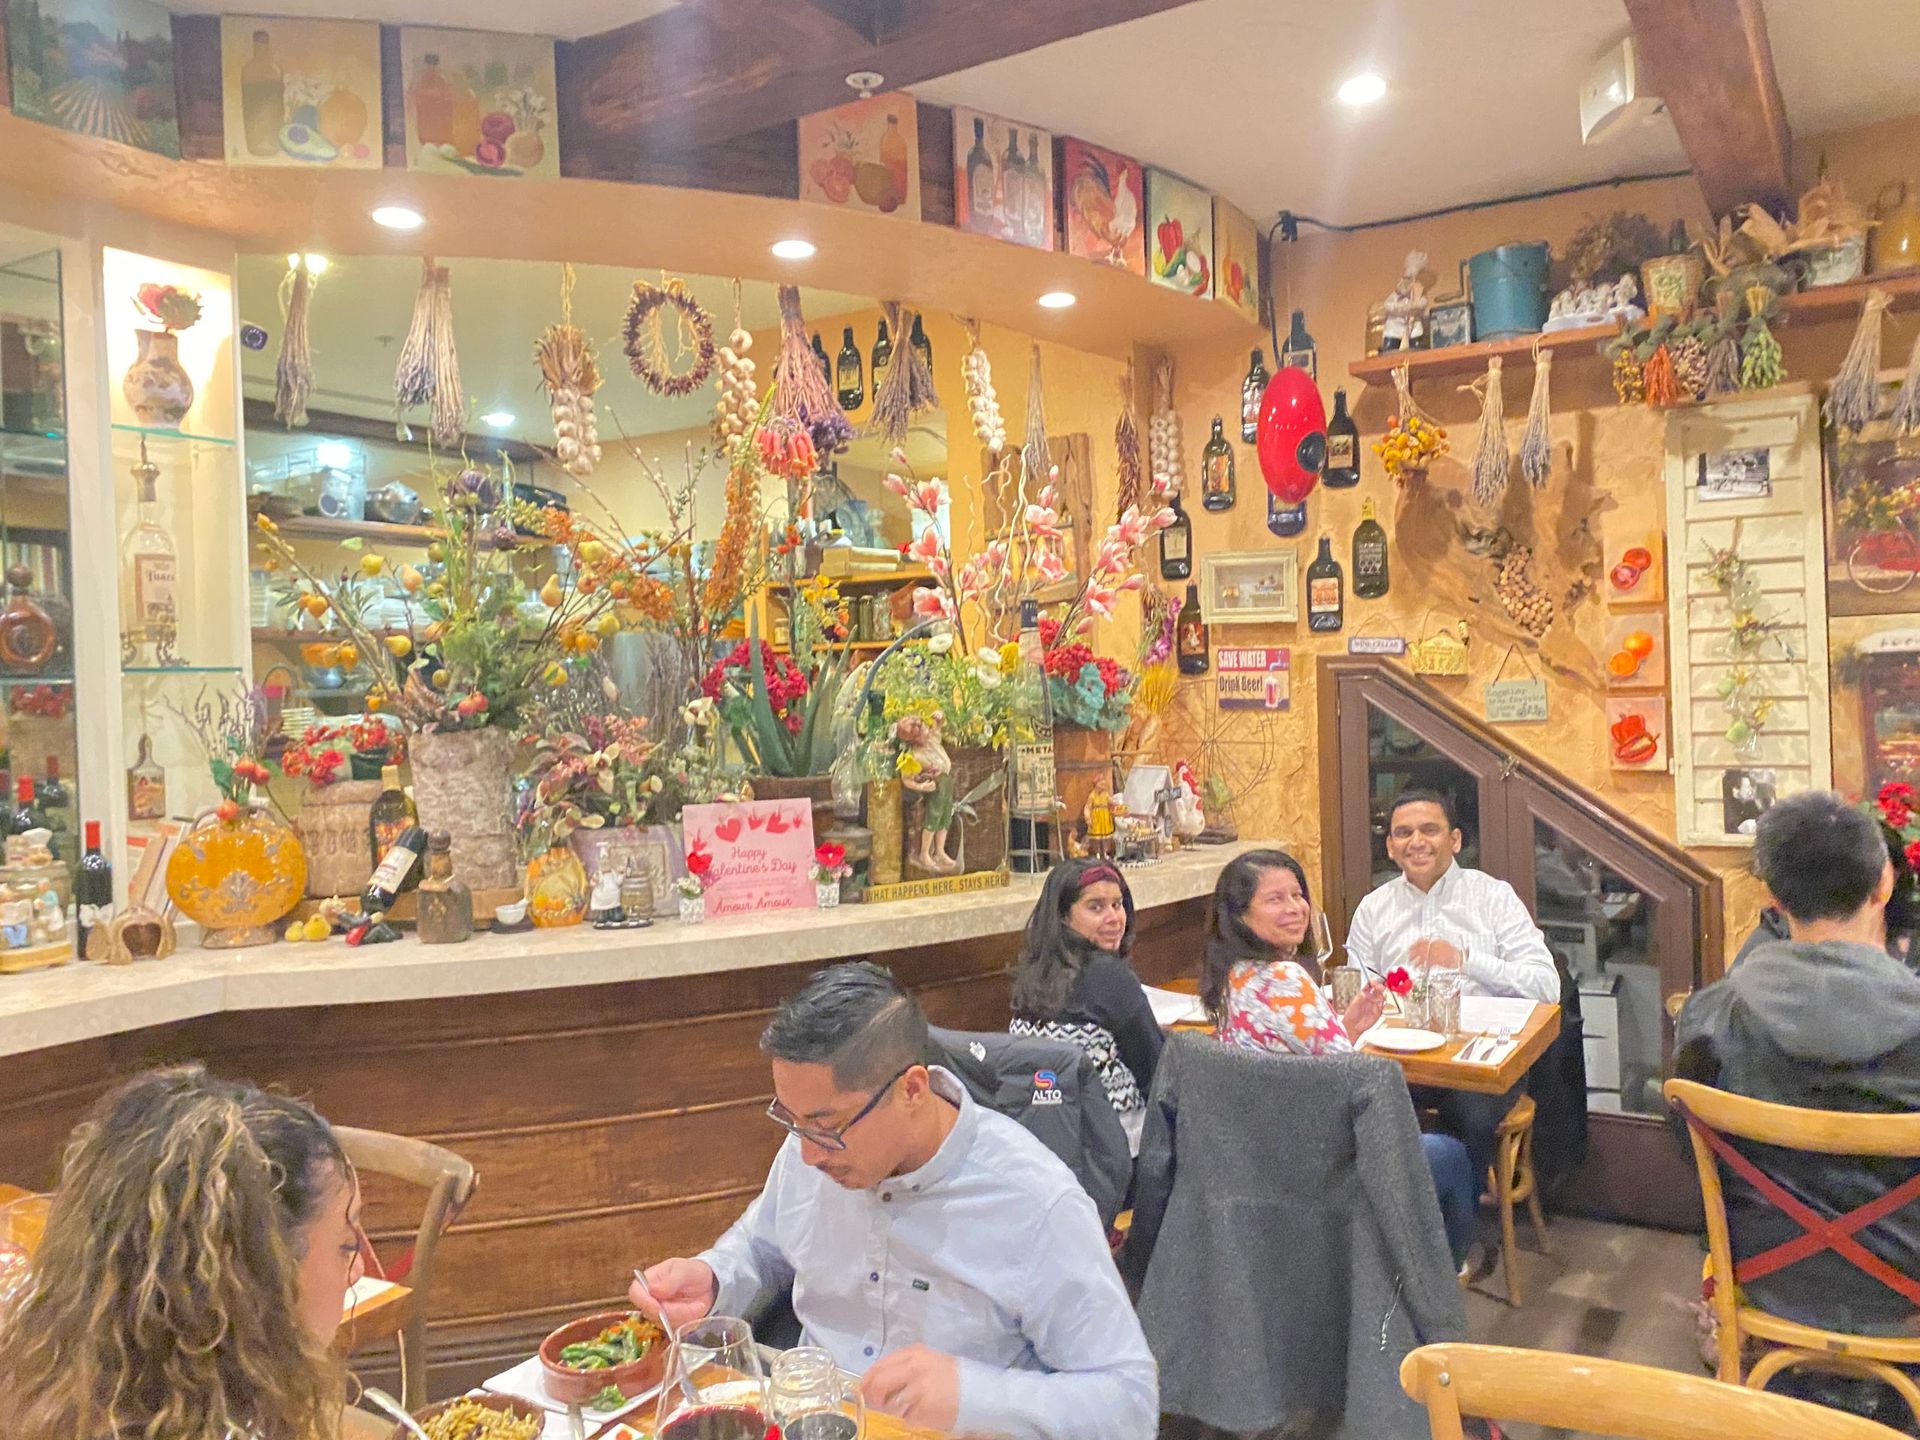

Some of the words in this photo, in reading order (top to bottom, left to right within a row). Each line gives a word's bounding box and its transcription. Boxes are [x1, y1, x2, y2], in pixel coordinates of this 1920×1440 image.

[1218, 650, 1239, 668] SAVE
[1239, 650, 1267, 668] WATER
[1219, 676, 1240, 692] Drink
[1241, 676, 1263, 692] Beer!
[731, 846, 767, 860] Happy
[771, 858, 797, 874] Day
[866, 887, 890, 901] WHAT
[891, 883, 930, 898] HAPPENS
[959, 876, 983, 890] STAYS
[714, 897, 753, 914] Amour
[755, 896, 793, 910] Amour
[1032, 1089, 1062, 1100] ALTO
